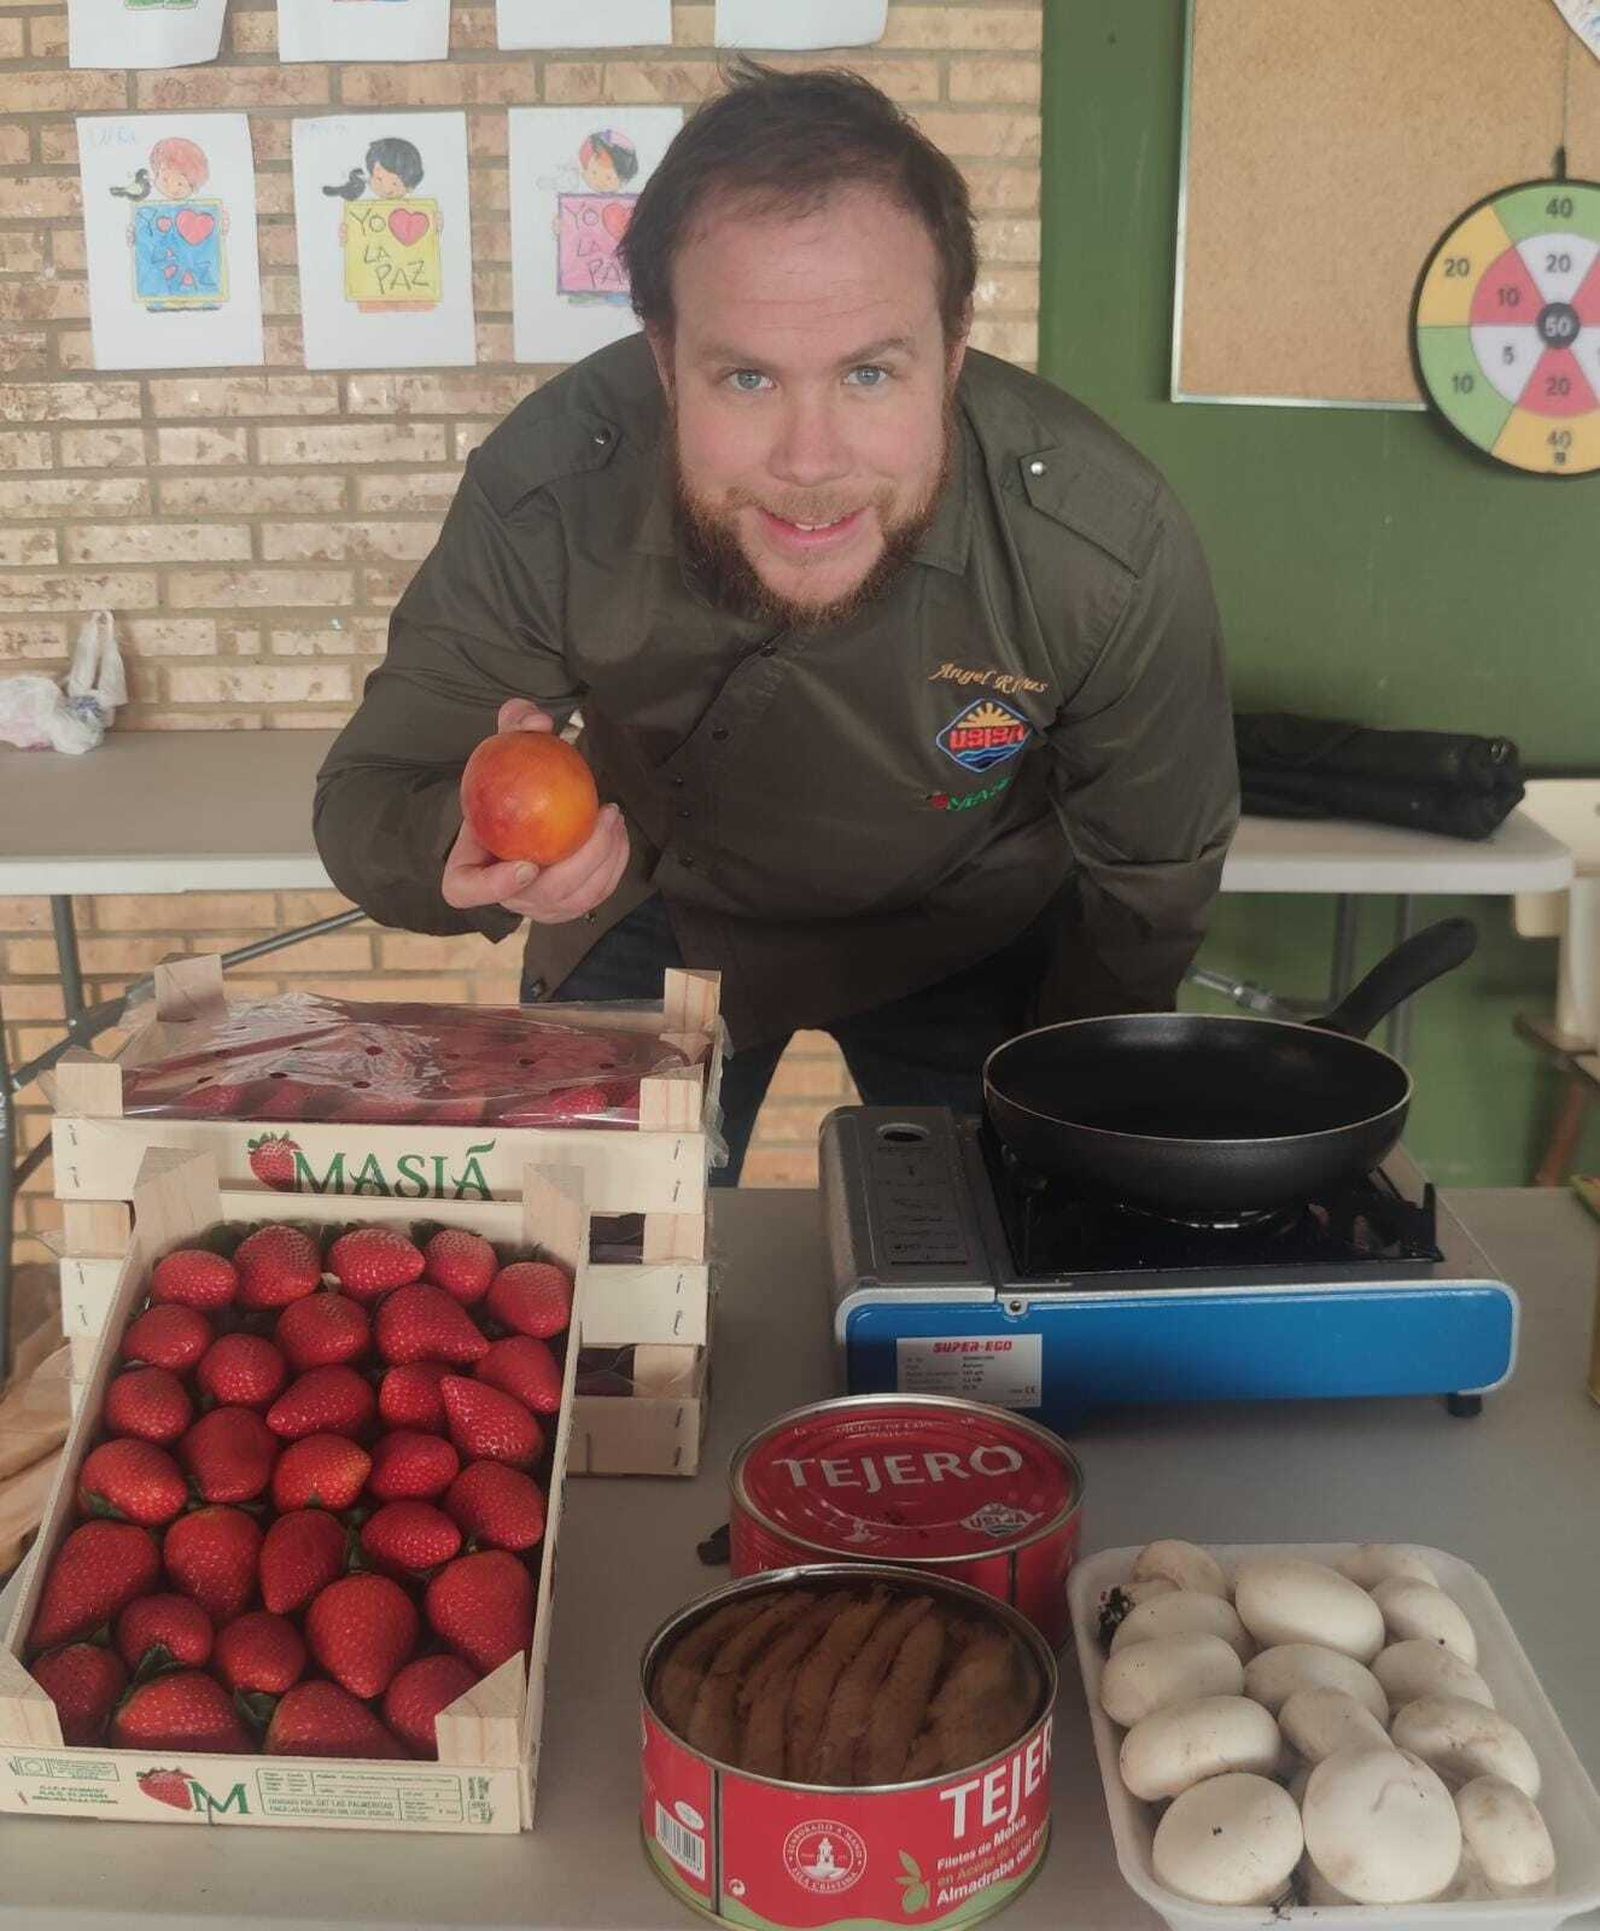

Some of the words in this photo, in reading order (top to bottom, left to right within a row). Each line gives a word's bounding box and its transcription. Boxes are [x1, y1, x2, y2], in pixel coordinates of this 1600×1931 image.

[562, 202, 600, 231] YO
[1546, 197, 1574, 218] 40
[348, 207, 386, 236] YO
[363, 245, 391, 265] LA
[1546, 253, 1572, 274] 20
[374, 258, 430, 295] PAZ
[1444, 257, 1470, 278] 20
[1498, 286, 1521, 308] 10
[1543, 316, 1571, 337] 50
[1502, 345, 1515, 365] 5
[1451, 374, 1474, 394] 10
[1545, 376, 1571, 396] 20
[1547, 429, 1572, 450] 40
[772, 1445, 1023, 1493] TEJERO
[191, 1780, 250, 1815] M
[938, 1858, 1015, 1906] Almadraba
